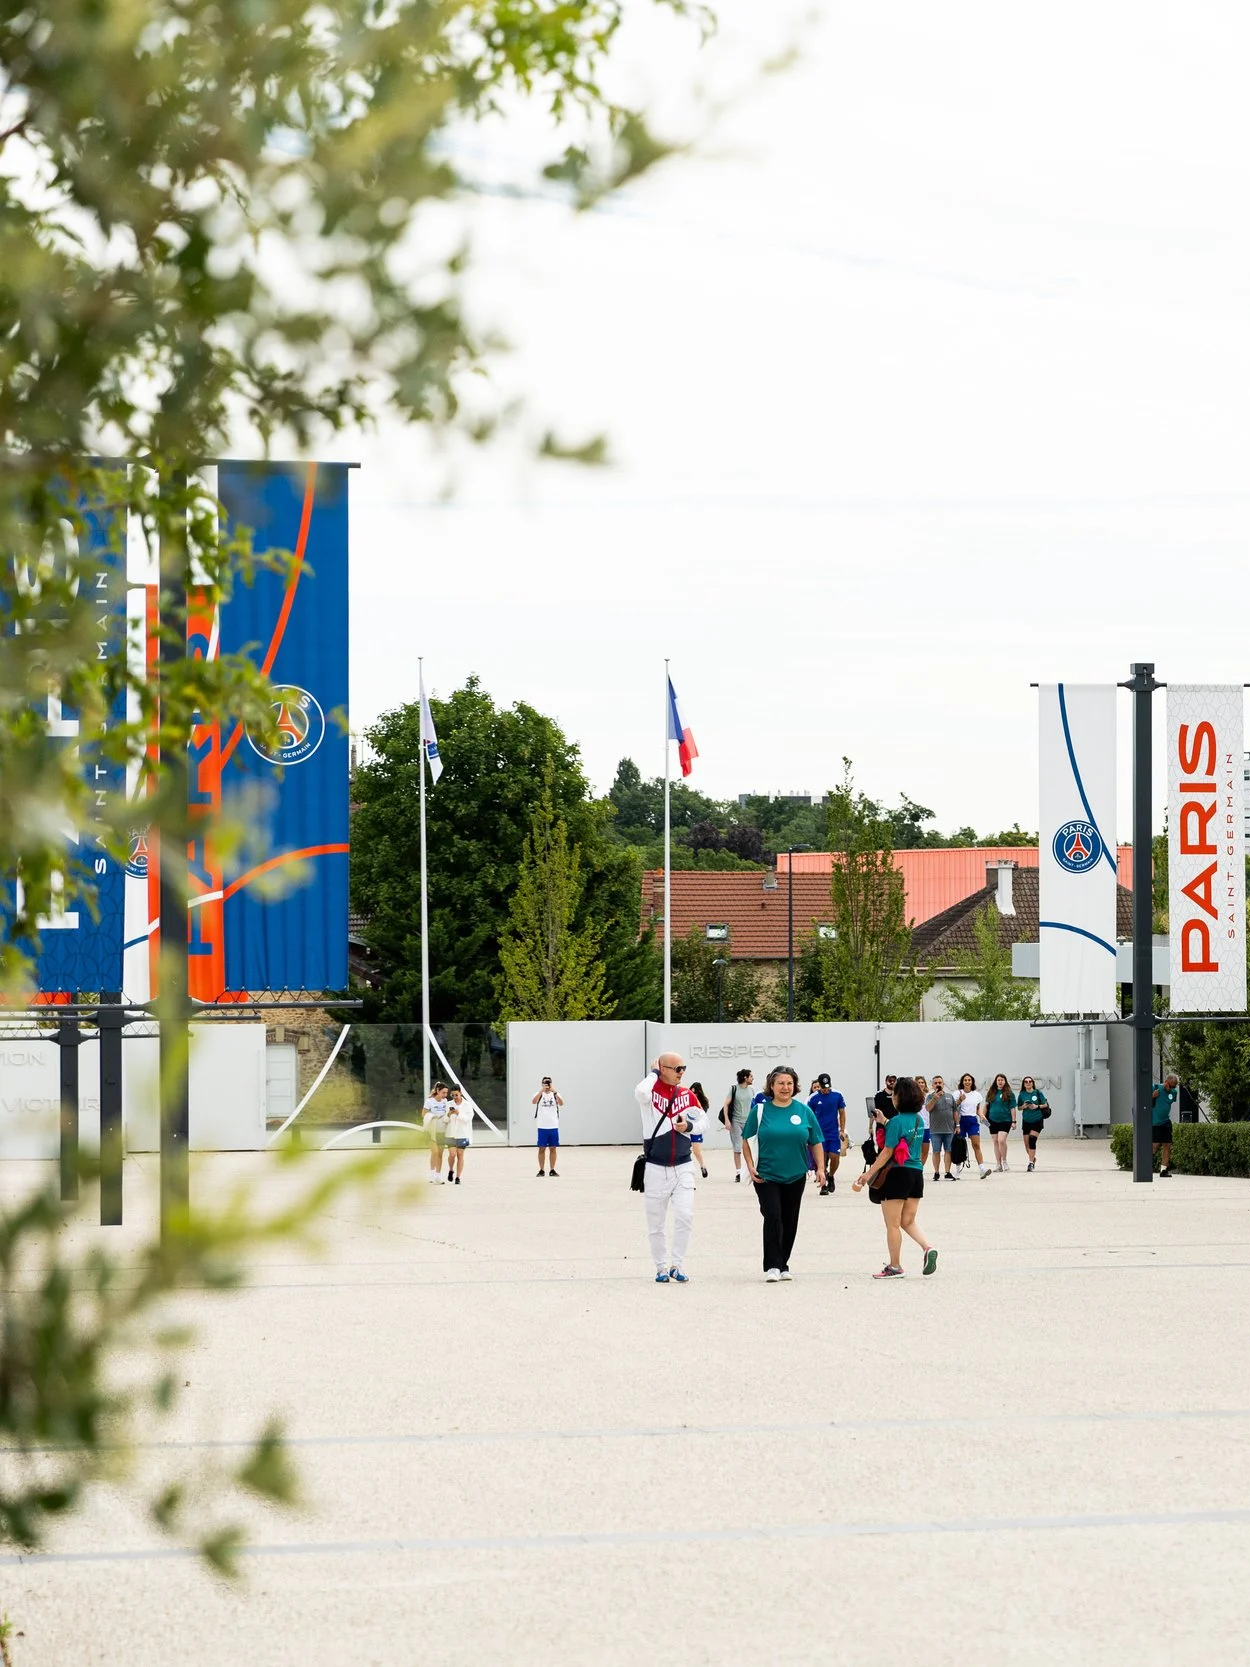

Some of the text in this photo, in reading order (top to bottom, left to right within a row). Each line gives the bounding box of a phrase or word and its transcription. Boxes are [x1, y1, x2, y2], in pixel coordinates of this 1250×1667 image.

[1062, 824, 1094, 837] PARIS
[1179, 721, 1219, 973] PARIS
[1226, 753, 1236, 939] SAINT-GERMAIN
[689, 1044, 797, 1059] RESPECT
